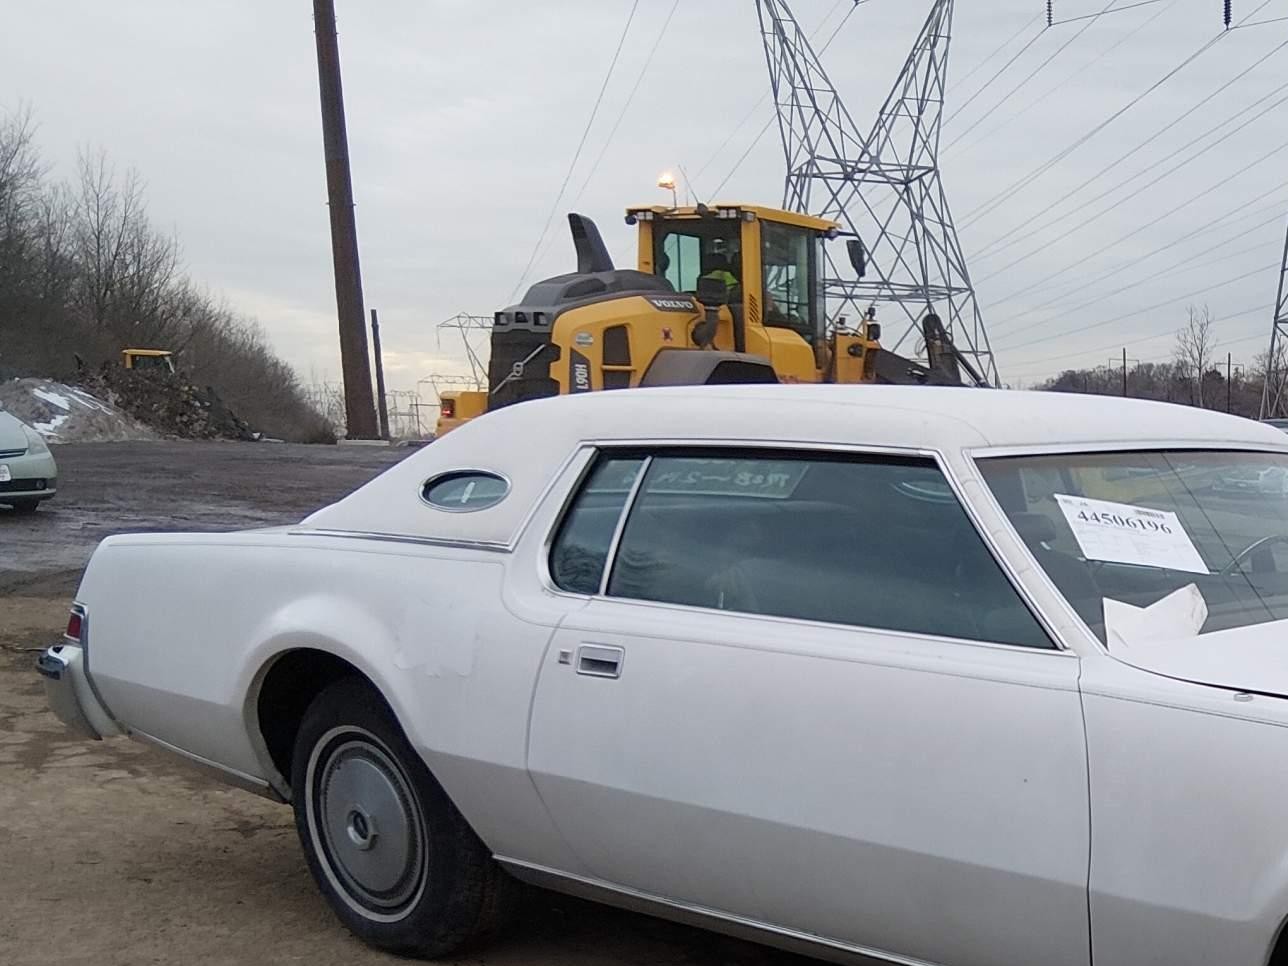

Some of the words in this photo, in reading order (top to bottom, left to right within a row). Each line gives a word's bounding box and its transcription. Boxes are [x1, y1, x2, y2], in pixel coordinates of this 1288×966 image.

[651, 299, 694, 309] VOLVO
[574, 363, 589, 390] L90H
[1077, 510, 1172, 535] 44506196
